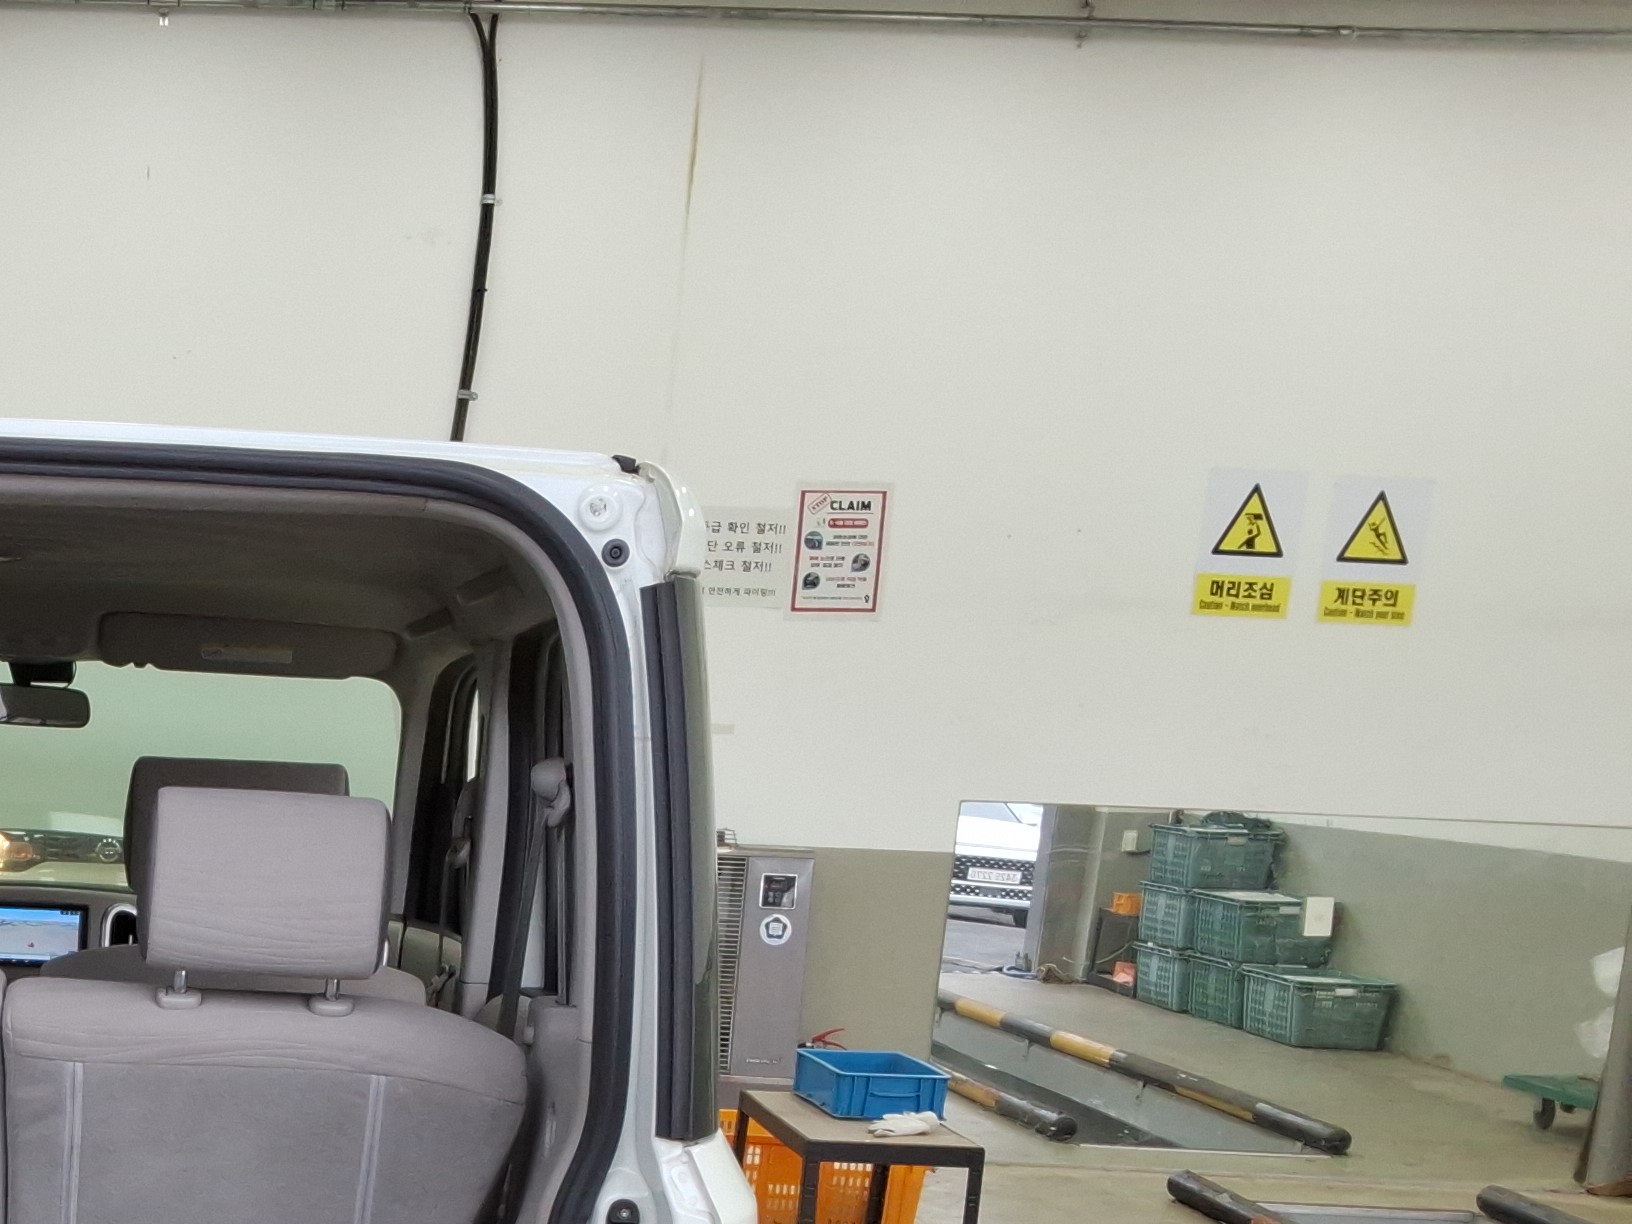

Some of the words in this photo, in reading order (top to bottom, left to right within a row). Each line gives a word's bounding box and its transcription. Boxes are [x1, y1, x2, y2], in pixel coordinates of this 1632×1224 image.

[830, 500, 872, 512] CLAIM
[728, 521, 750, 534] 확인
[722, 541, 746, 553] 오류
[1209, 579, 1275, 601] 머리조심
[1333, 586, 1400, 608] 계단주의
